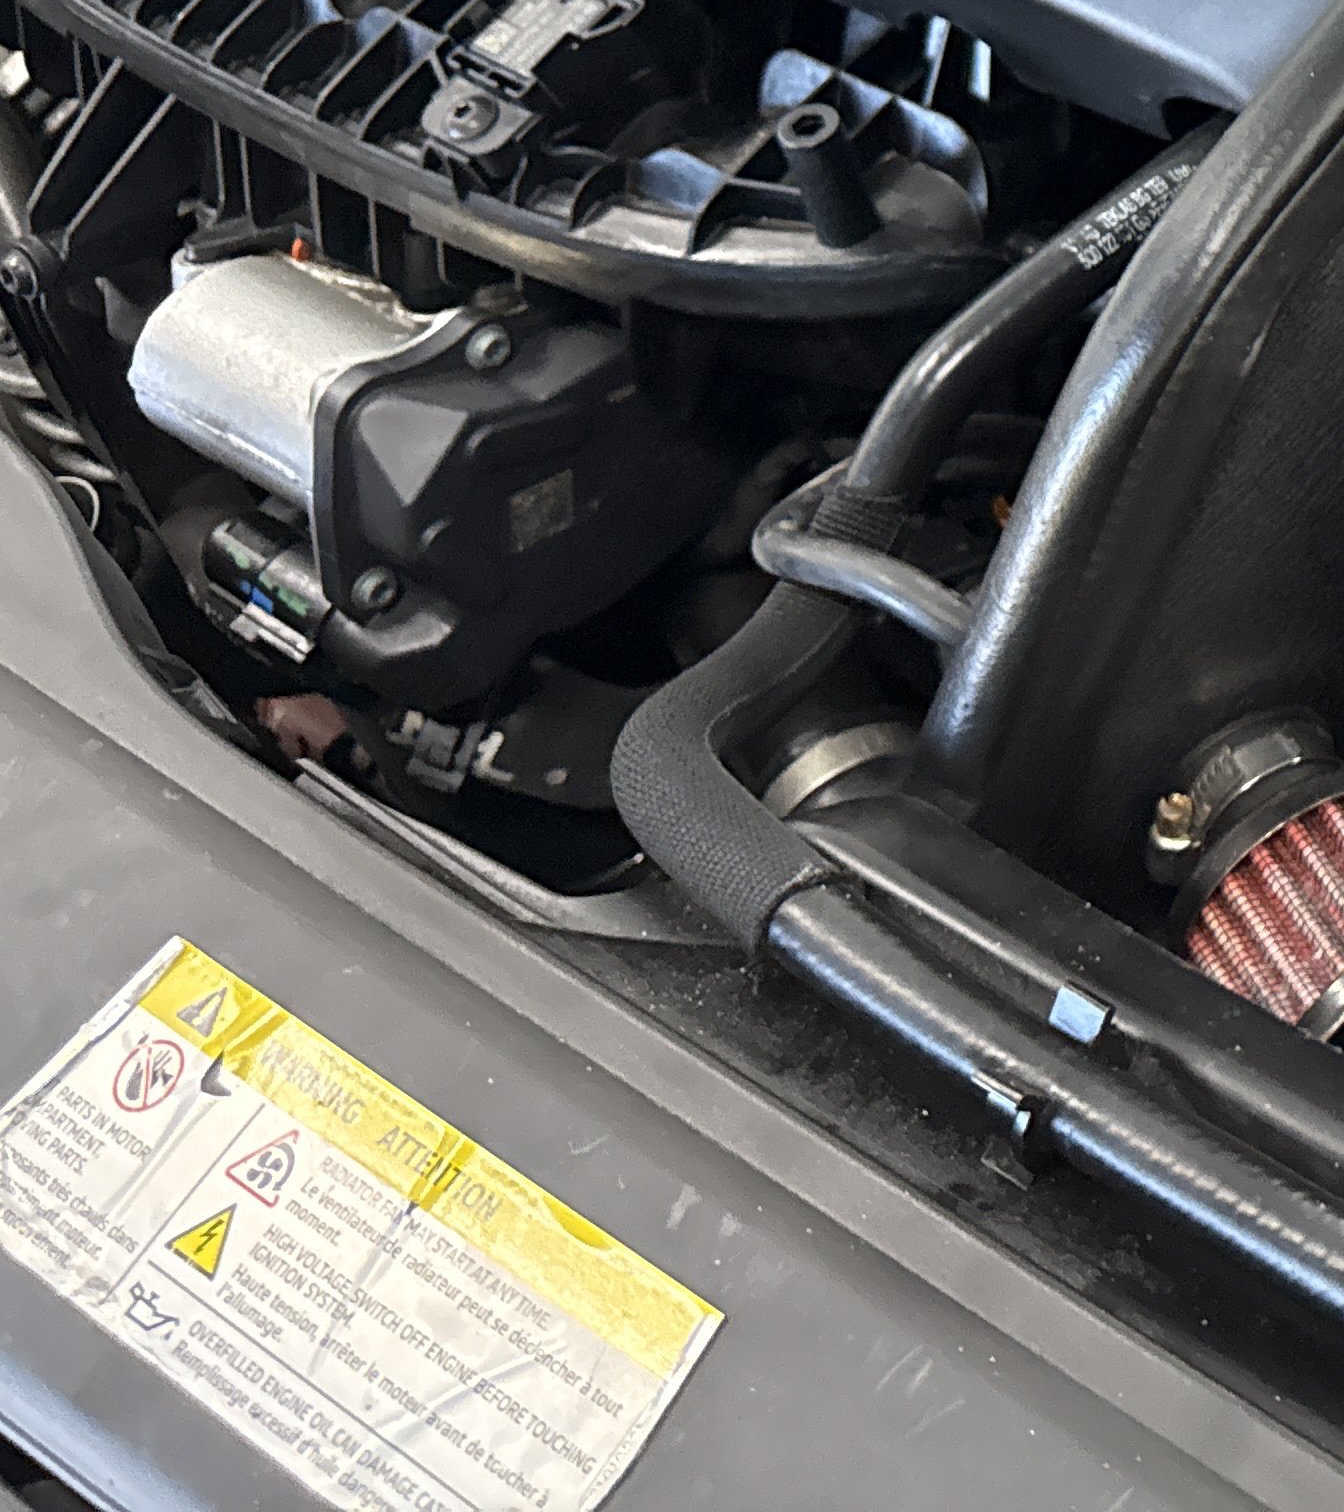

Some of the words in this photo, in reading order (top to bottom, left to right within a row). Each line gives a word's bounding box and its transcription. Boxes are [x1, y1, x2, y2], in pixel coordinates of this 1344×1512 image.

[44, 1135, 91, 1176] PARTS.
[54, 1083, 97, 1121] PARTS
[90, 1110, 110, 1131] IN
[103, 1120, 153, 1163] MOTOR
[257, 1039, 367, 1127] WARNING
[374, 1120, 504, 1223] ATTENTION
[246, 1240, 309, 1292] IGNITION
[301, 1281, 360, 1331] SYSTEM.
[283, 1197, 345, 1248] moment.
[317, 1155, 385, 1210] RADIATOR
[402, 1216, 438, 1248] MAY
[430, 1236, 477, 1277] START
[468, 1263, 494, 1289] AT
[261, 1222, 300, 1257] HIGH
[347, 1286, 404, 1334] SWITCH
[397, 1322, 431, 1352] OFF
[423, 1340, 478, 1387] ENGINE
[471, 1376, 530, 1426] BEFORE
[523, 1414, 598, 1476] TOUCHING
[299, 1176, 323, 1200] Le
[316, 1188, 391, 1249] ventilateur
[381, 1236, 405, 1260] de
[399, 1249, 465, 1303] radiateur
[455, 1292, 495, 1328] peut
[490, 1317, 510, 1337] se
[577, 1375, 597, 1397] à
[588, 1386, 625, 1419] tout
[165, 1338, 256, 1414] Remplissage
[184, 1318, 267, 1385] OVERFILLED
[257, 1374, 314, 1422] ENGINE
[306, 1410, 337, 1439] OIL
[328, 1427, 362, 1459] CAN
[354, 1447, 420, 1502] DAMAGE
[228, 1262, 276, 1303] Haute
[265, 1292, 325, 1343] tension,
[317, 1328, 371, 1375] arrêter
[361, 1360, 384, 1385] le
[375, 1375, 428, 1419] moteur
[422, 1408, 469, 1448] avant
[462, 1437, 488, 1462] de
[534, 1490, 552, 1510] à
